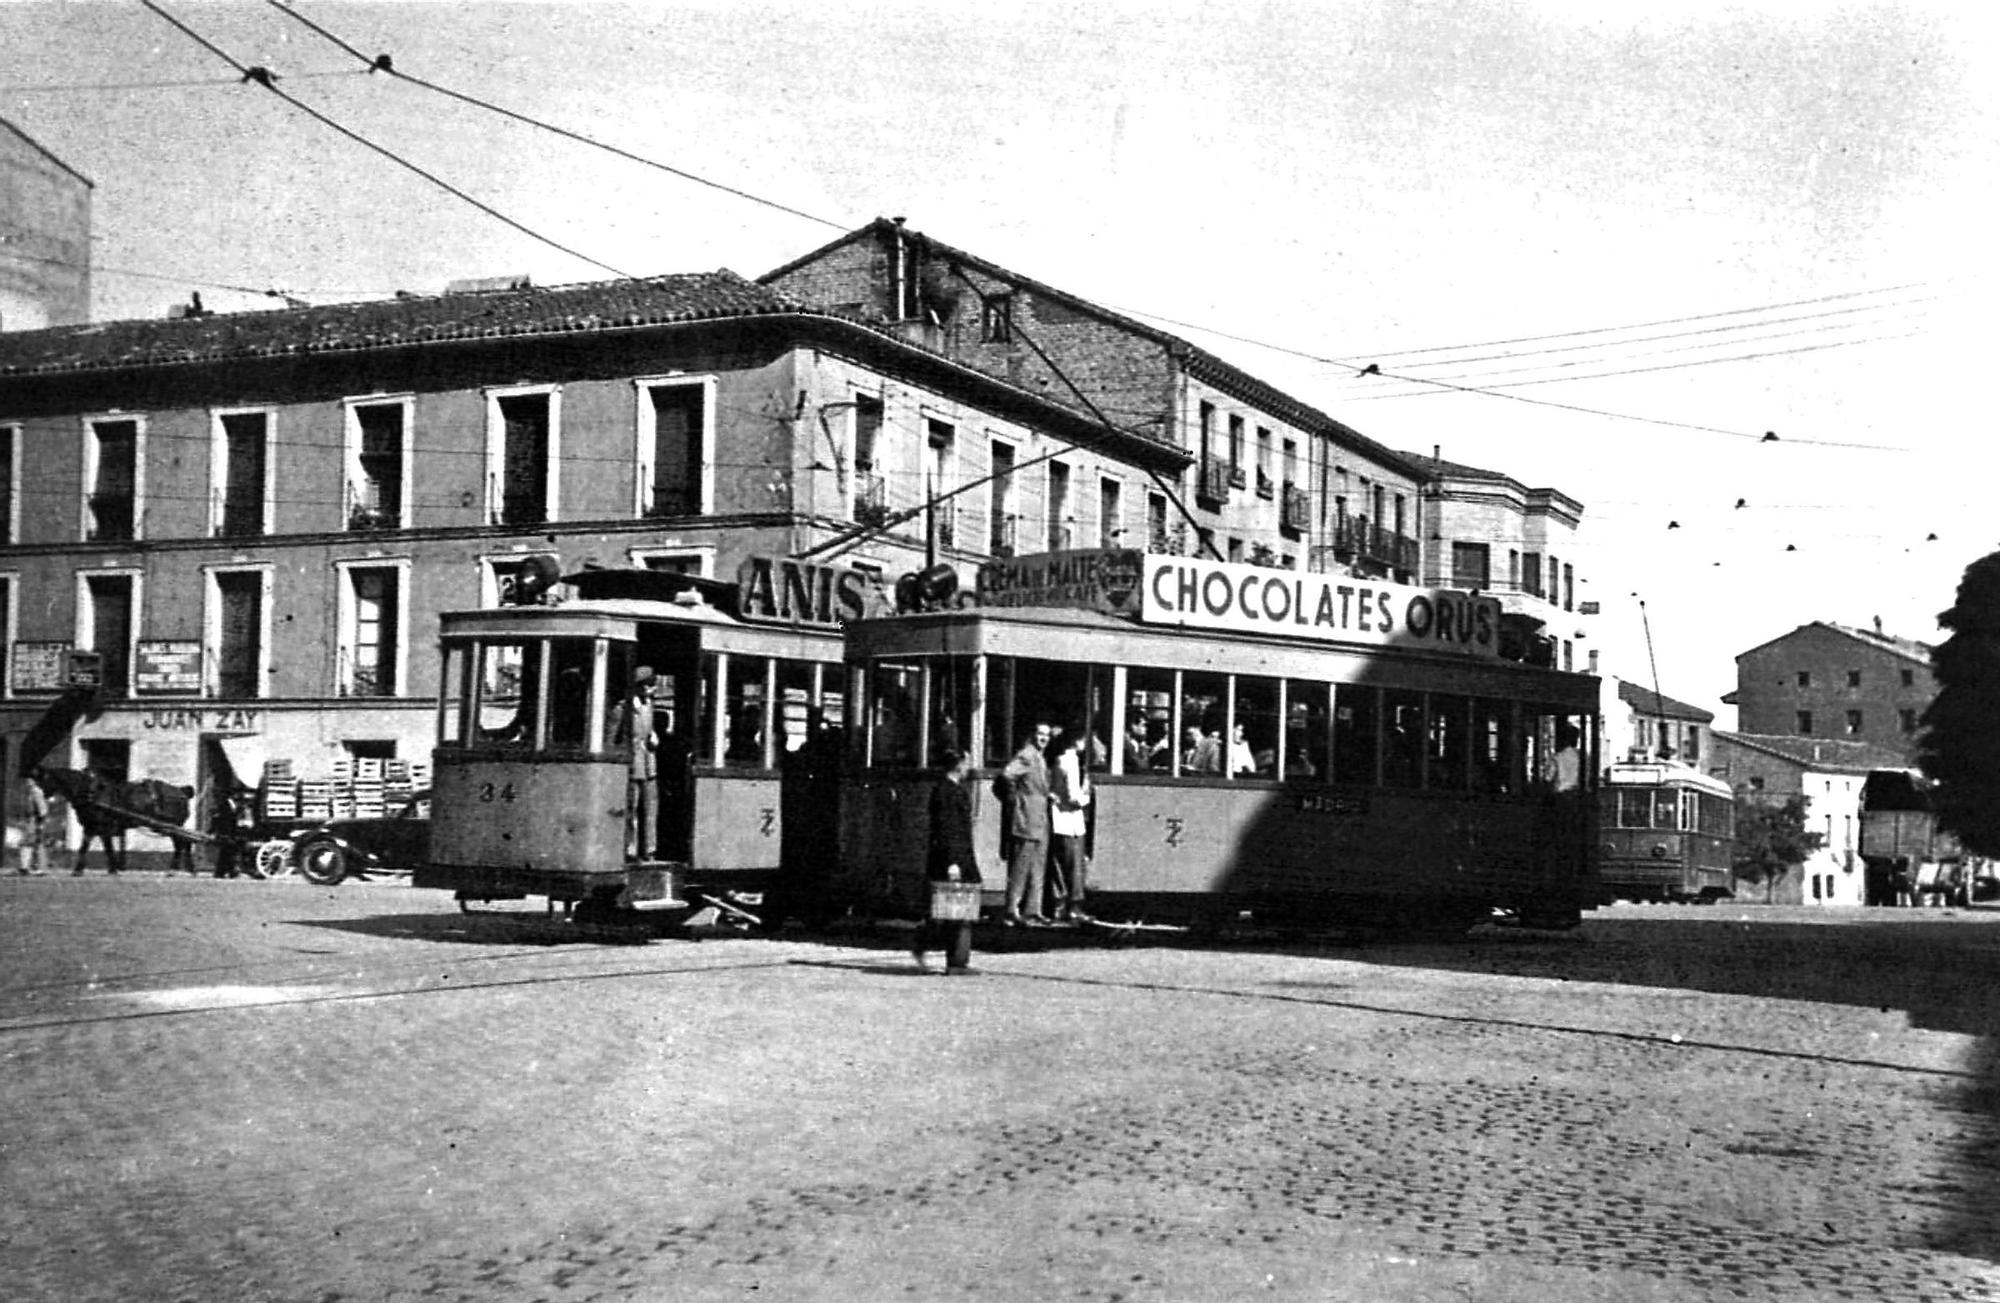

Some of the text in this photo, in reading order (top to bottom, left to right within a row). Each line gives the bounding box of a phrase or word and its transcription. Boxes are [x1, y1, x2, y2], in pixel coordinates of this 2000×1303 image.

[744, 557, 866, 621] ANIS
[1152, 564, 1394, 634] CHOCOLATES
[1405, 591, 1495, 645] ORUS
[143, 709, 258, 729] JUAN ZAY
[480, 781, 517, 804] 34
